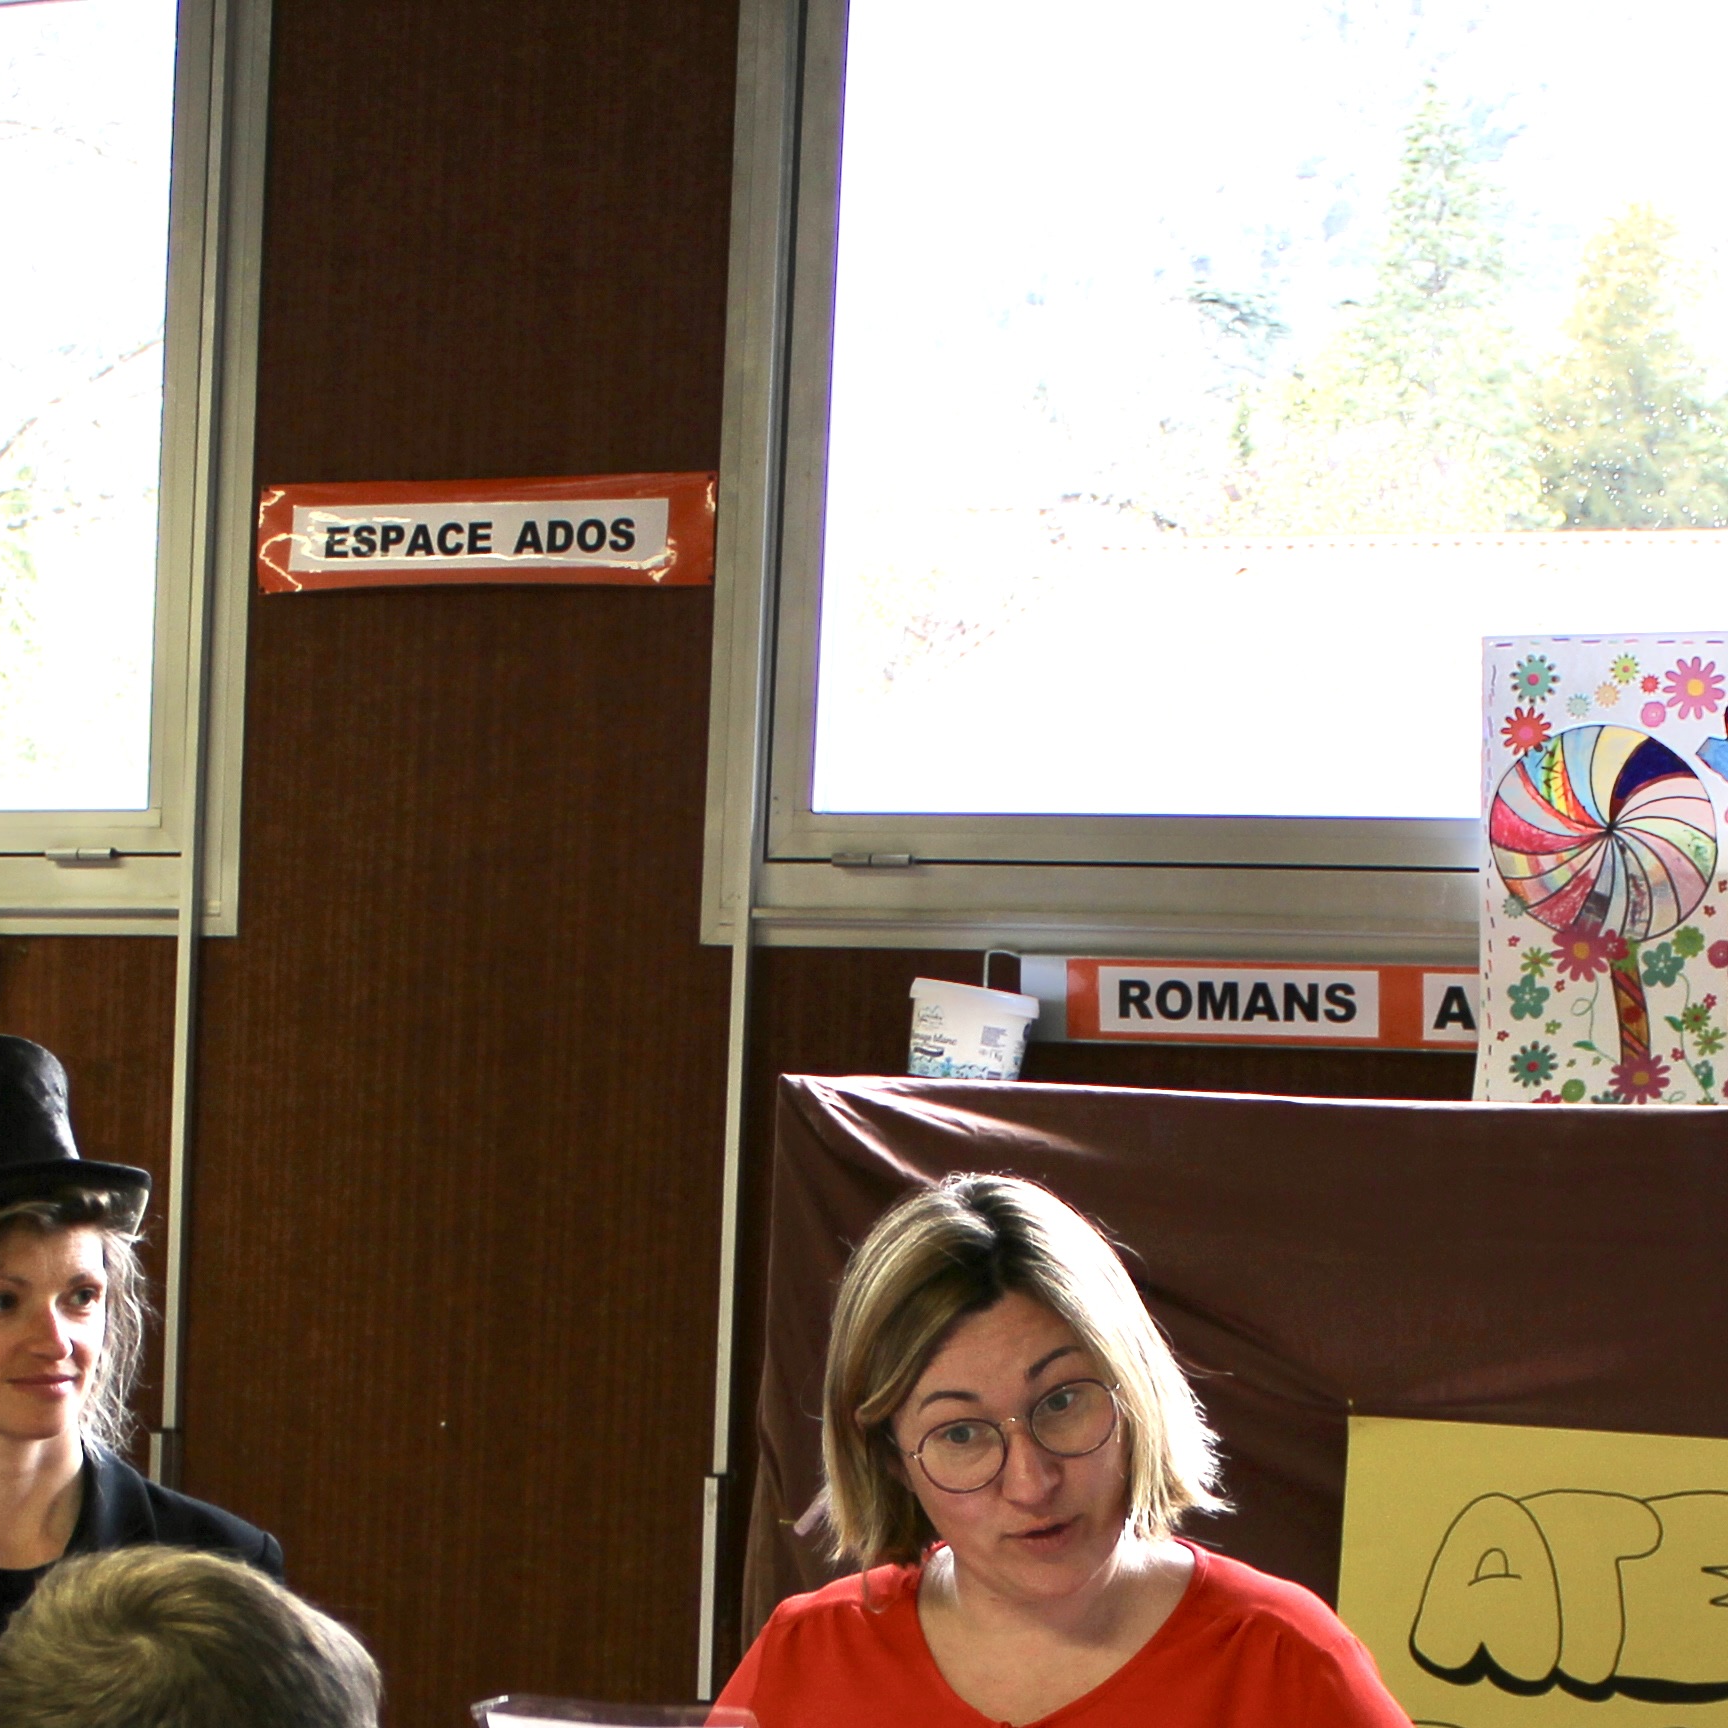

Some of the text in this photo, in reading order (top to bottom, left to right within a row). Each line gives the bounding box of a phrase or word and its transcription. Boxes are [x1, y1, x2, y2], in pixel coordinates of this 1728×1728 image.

[324, 517, 636, 558] ESPACE ADOS
[1118, 978, 1356, 1022] ROMANS
